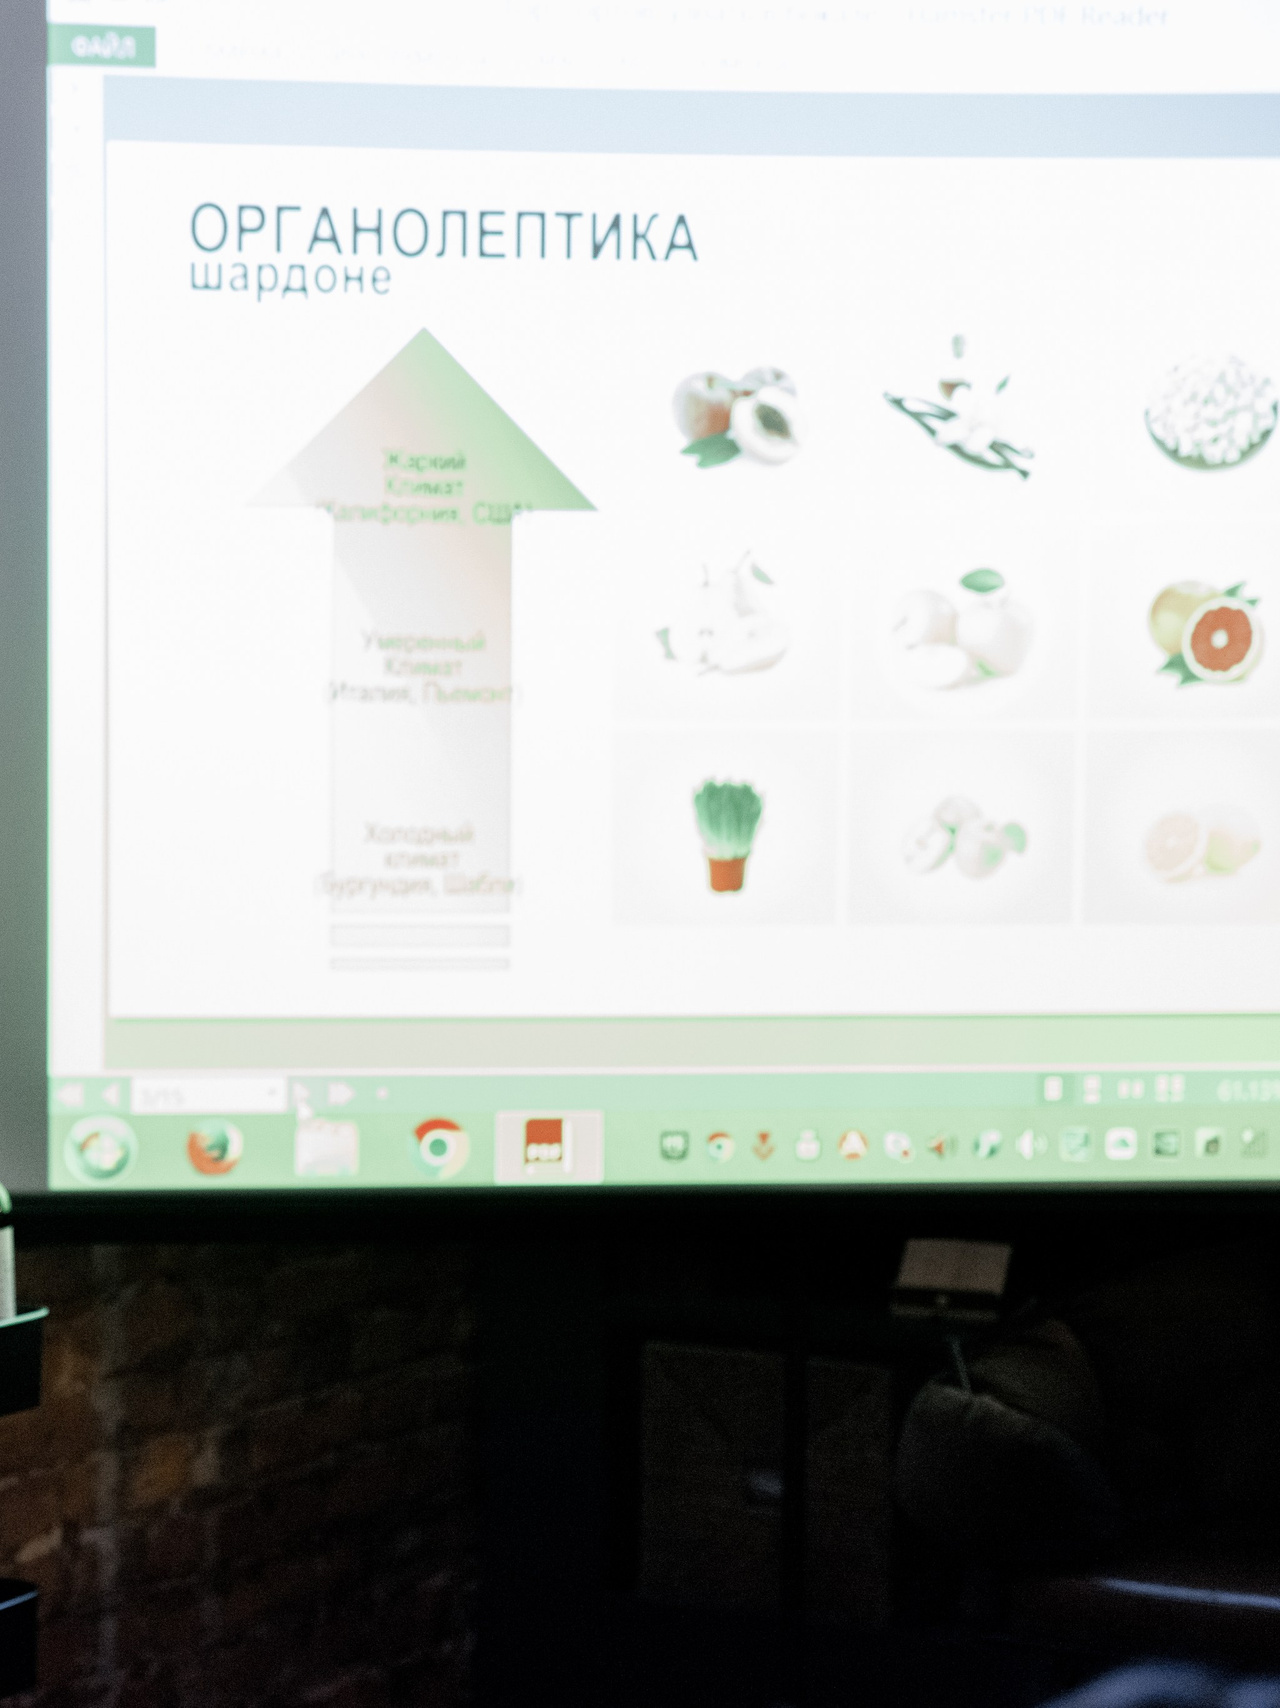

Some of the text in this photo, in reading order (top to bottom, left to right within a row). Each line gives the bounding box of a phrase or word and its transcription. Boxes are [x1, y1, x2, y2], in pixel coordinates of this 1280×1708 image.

[1080, 6, 1169, 27] Reader
[70, 32, 136, 59] ФАЙЛ
[190, 202, 698, 261] ОРГАНОЛЕПТИКА
[190, 262, 392, 301] шардоне
